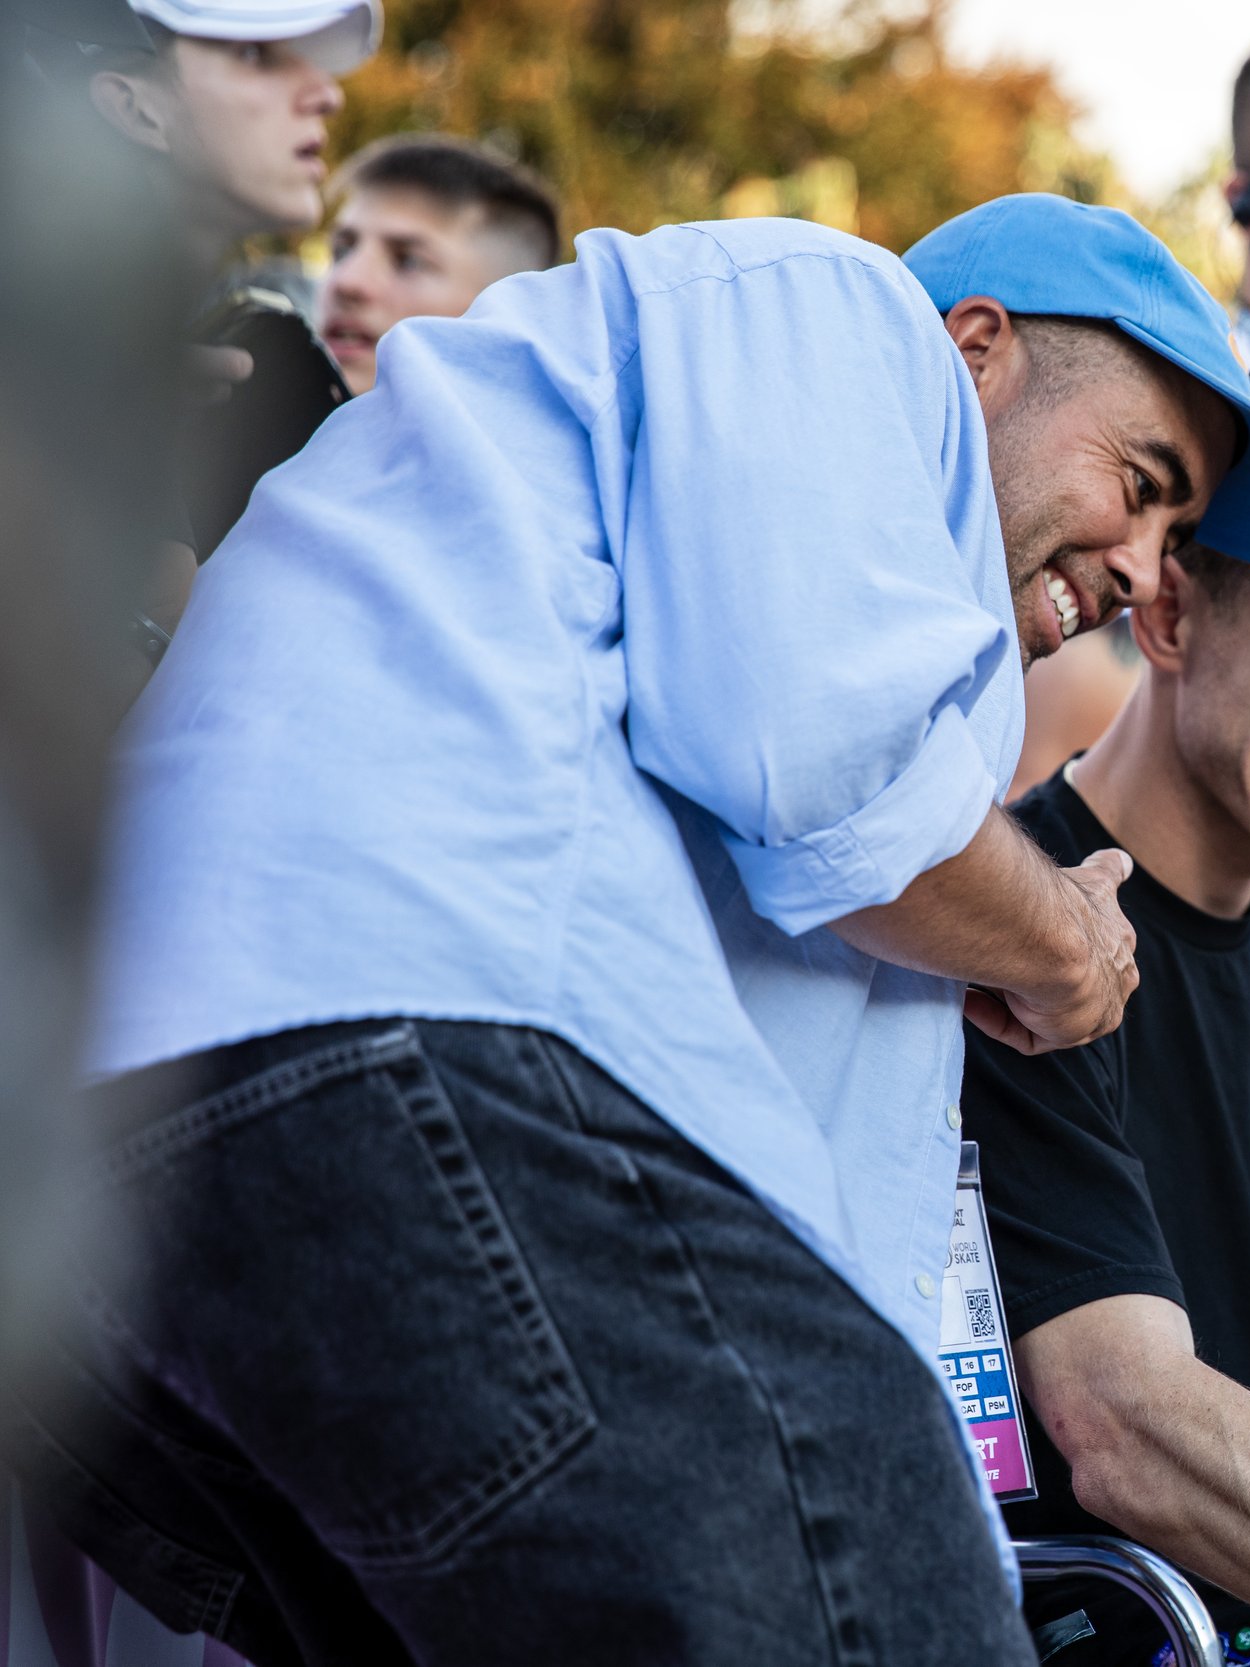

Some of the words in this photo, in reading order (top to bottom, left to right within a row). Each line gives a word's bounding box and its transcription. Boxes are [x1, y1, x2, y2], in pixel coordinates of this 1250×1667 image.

[952, 1241, 978, 1252] WORLD
[954, 1252, 981, 1265] SKATE
[942, 1364, 951, 1373] 15
[965, 1361, 975, 1370] 16
[988, 1358, 996, 1367] 17
[956, 1382, 973, 1392] FOP
[961, 1404, 976, 1415] CAT
[988, 1400, 1006, 1411] PSM
